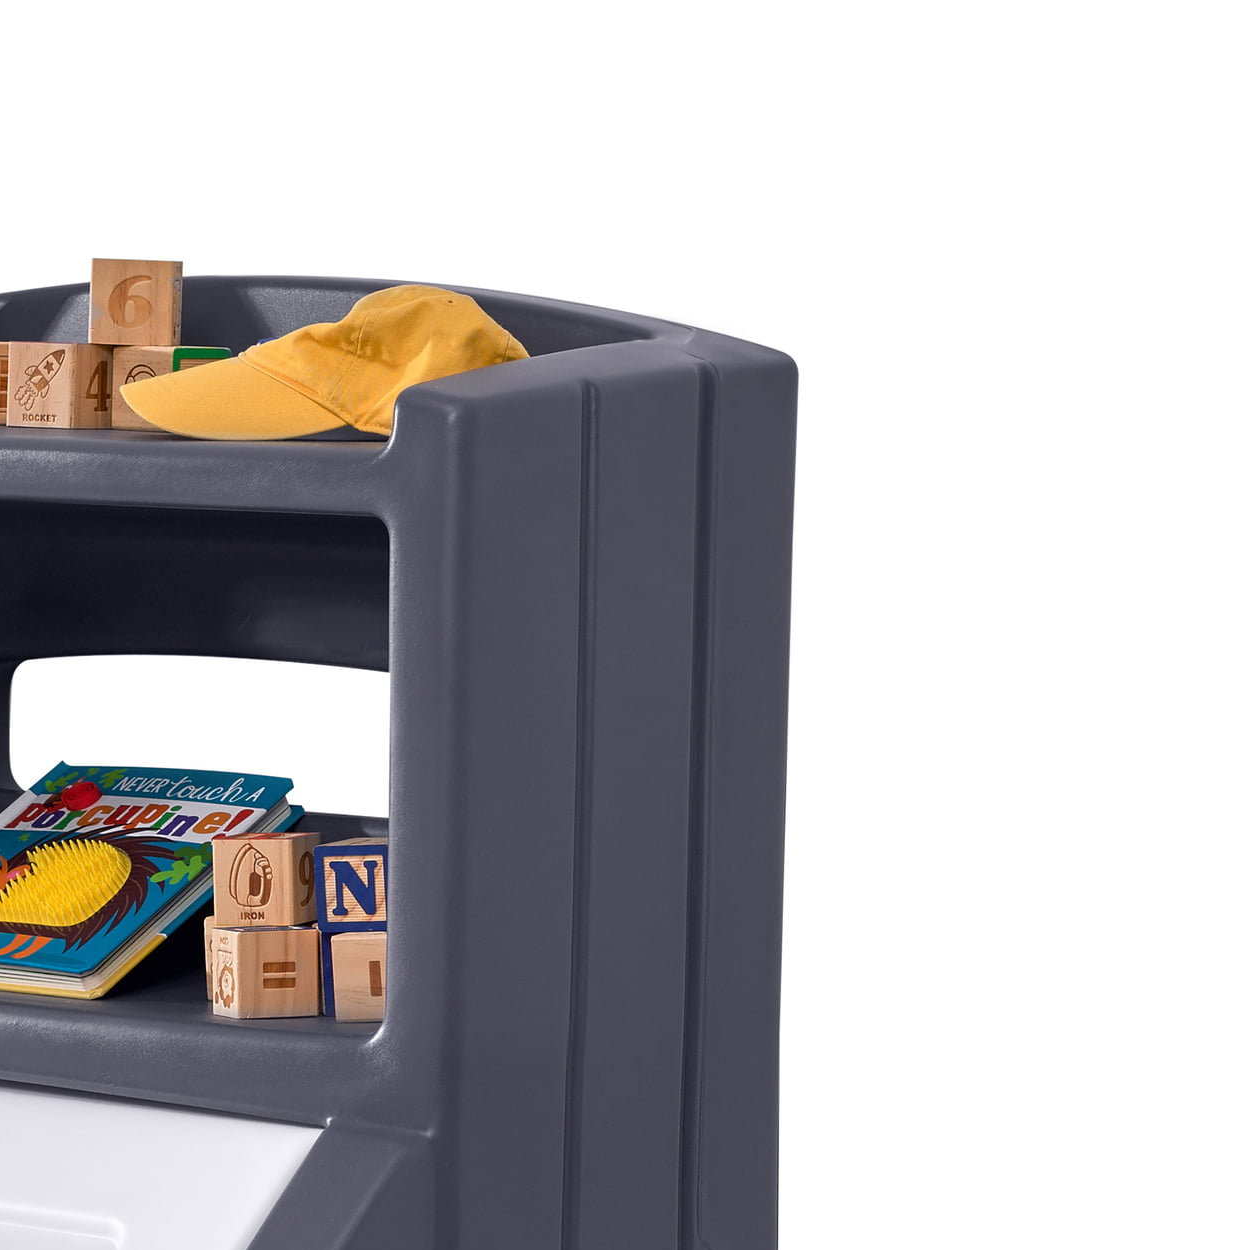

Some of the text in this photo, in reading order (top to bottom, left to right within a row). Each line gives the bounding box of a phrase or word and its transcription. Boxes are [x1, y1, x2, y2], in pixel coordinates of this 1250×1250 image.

[107, 274, 153, 329] 6
[85, 360, 111, 412] 4
[21, 413, 57, 423] ROCKET
[112, 775, 266, 803] NEVER touch A
[300, 851, 315, 907] 9
[329, 860, 378, 916] N
[240, 911, 265, 920] IRON
